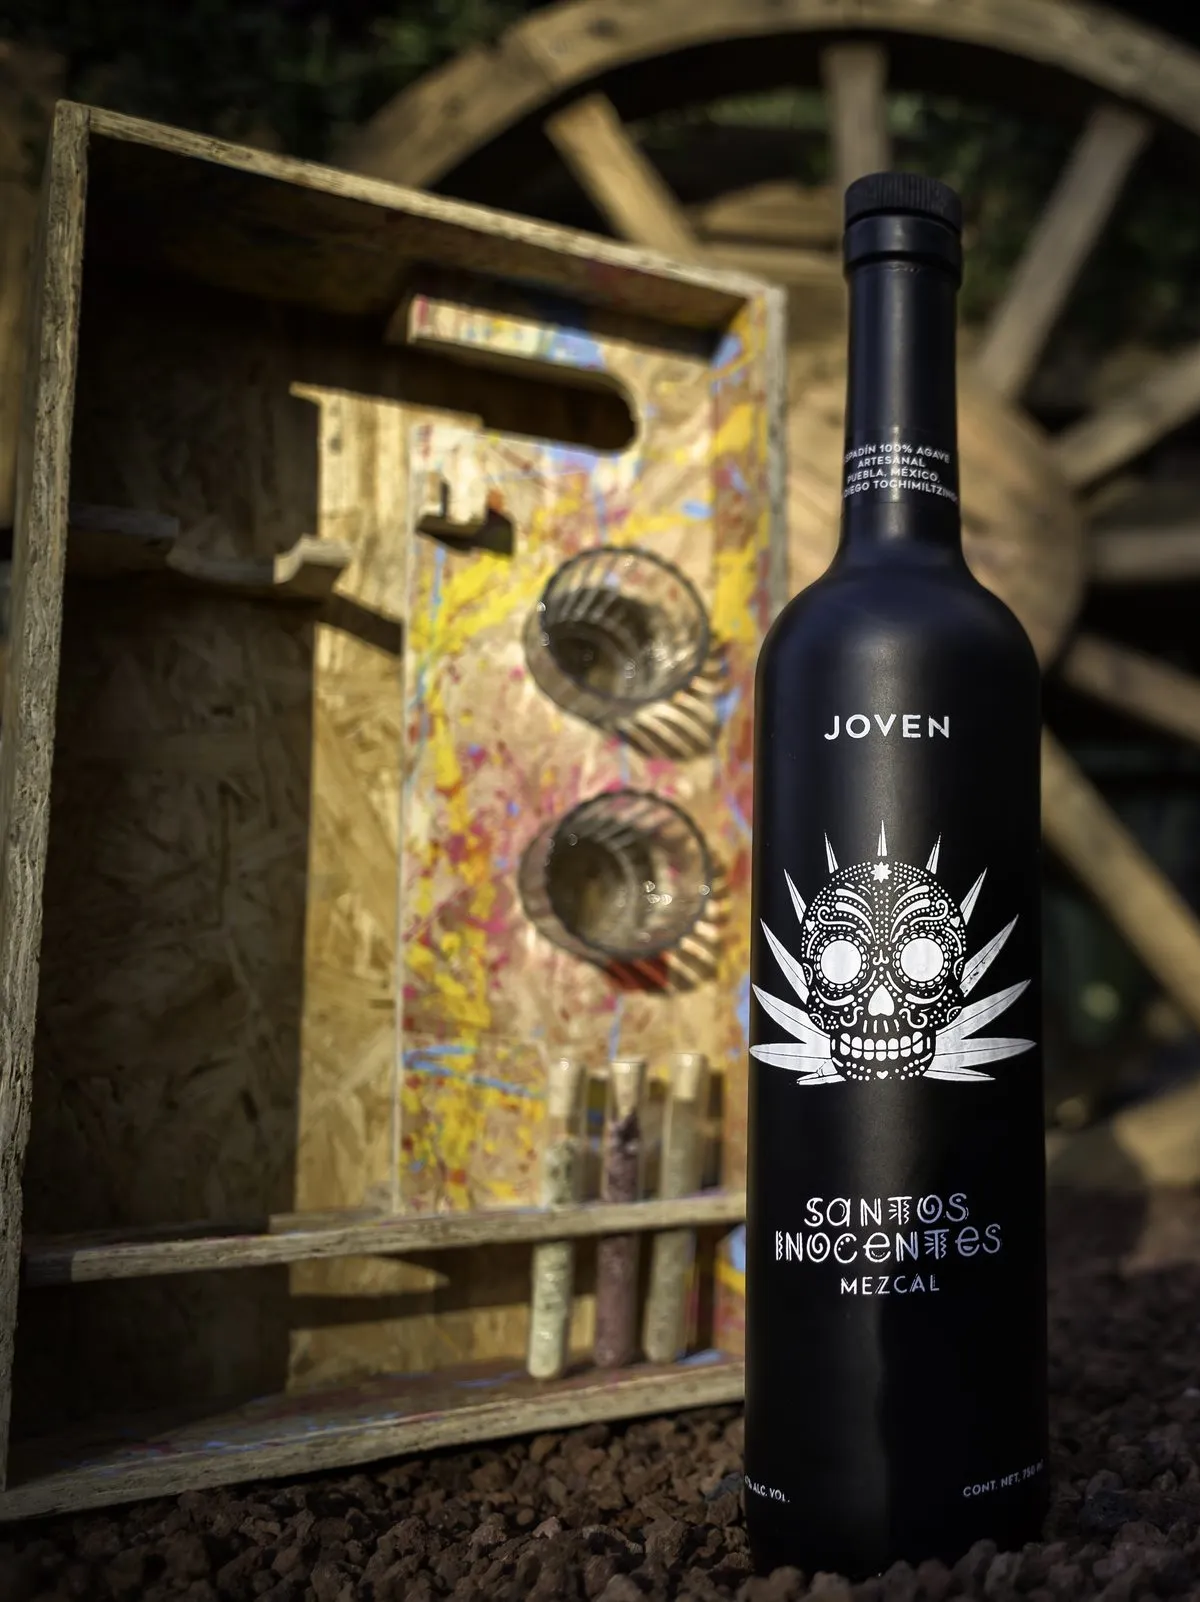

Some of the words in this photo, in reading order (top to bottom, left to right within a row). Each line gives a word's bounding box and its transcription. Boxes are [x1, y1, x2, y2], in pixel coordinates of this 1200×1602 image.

[845, 444, 876, 462] SPADÍN
[879, 443, 912, 454] 100%
[916, 447, 950, 463] AGAVE
[857, 455, 926, 468] ARTESANAL
[847, 468, 887, 483] PUEBLA,
[890, 466, 940, 482] MÉXICO,
[824, 713, 950, 740] JOVEN
[840, 1273, 940, 1294] MEZCAL
